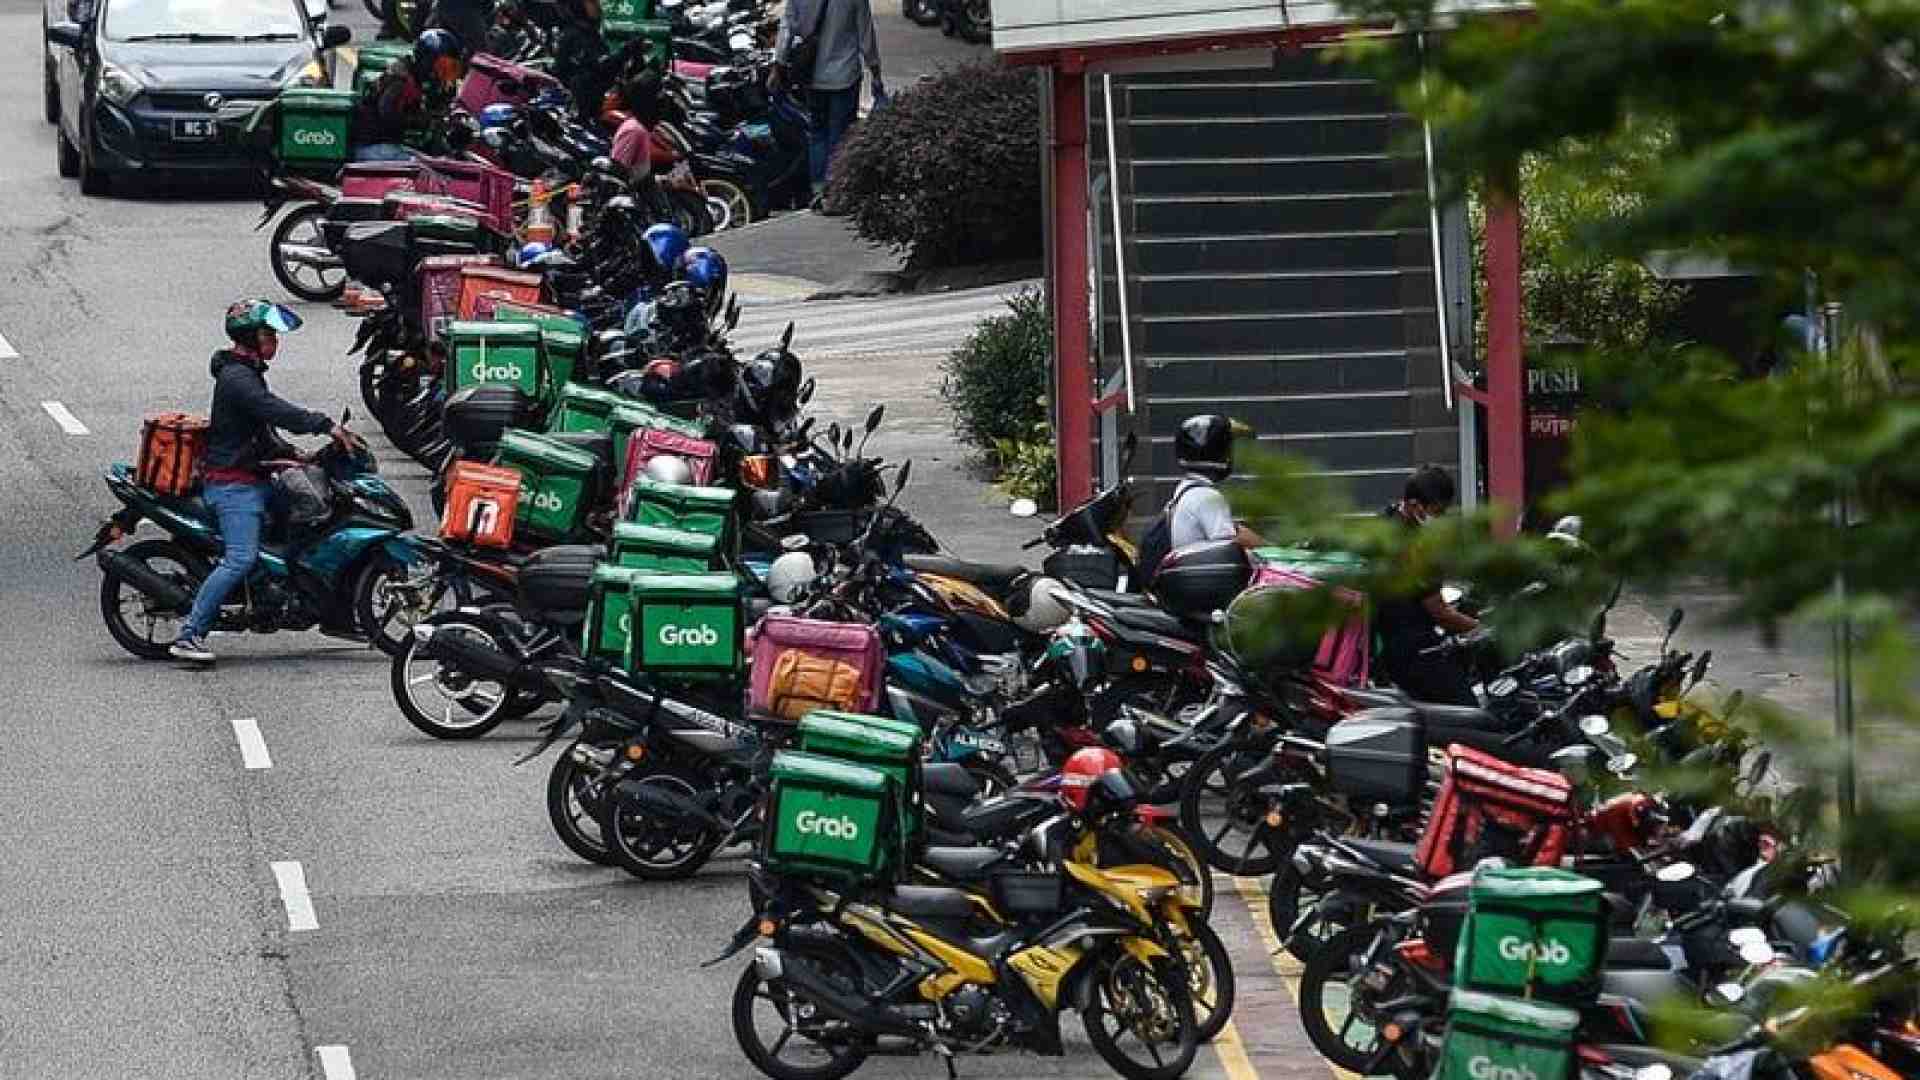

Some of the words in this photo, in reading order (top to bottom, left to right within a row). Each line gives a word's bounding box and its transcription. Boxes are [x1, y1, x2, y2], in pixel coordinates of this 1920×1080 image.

[293, 129, 335, 145] Grab
[471, 362, 521, 381] Grab
[1528, 367, 1578, 394] PUSH
[657, 623, 717, 647] Grab
[795, 810, 858, 841] Grab
[1498, 935, 1569, 965] Grab
[1467, 1055, 1536, 1080] Grab
